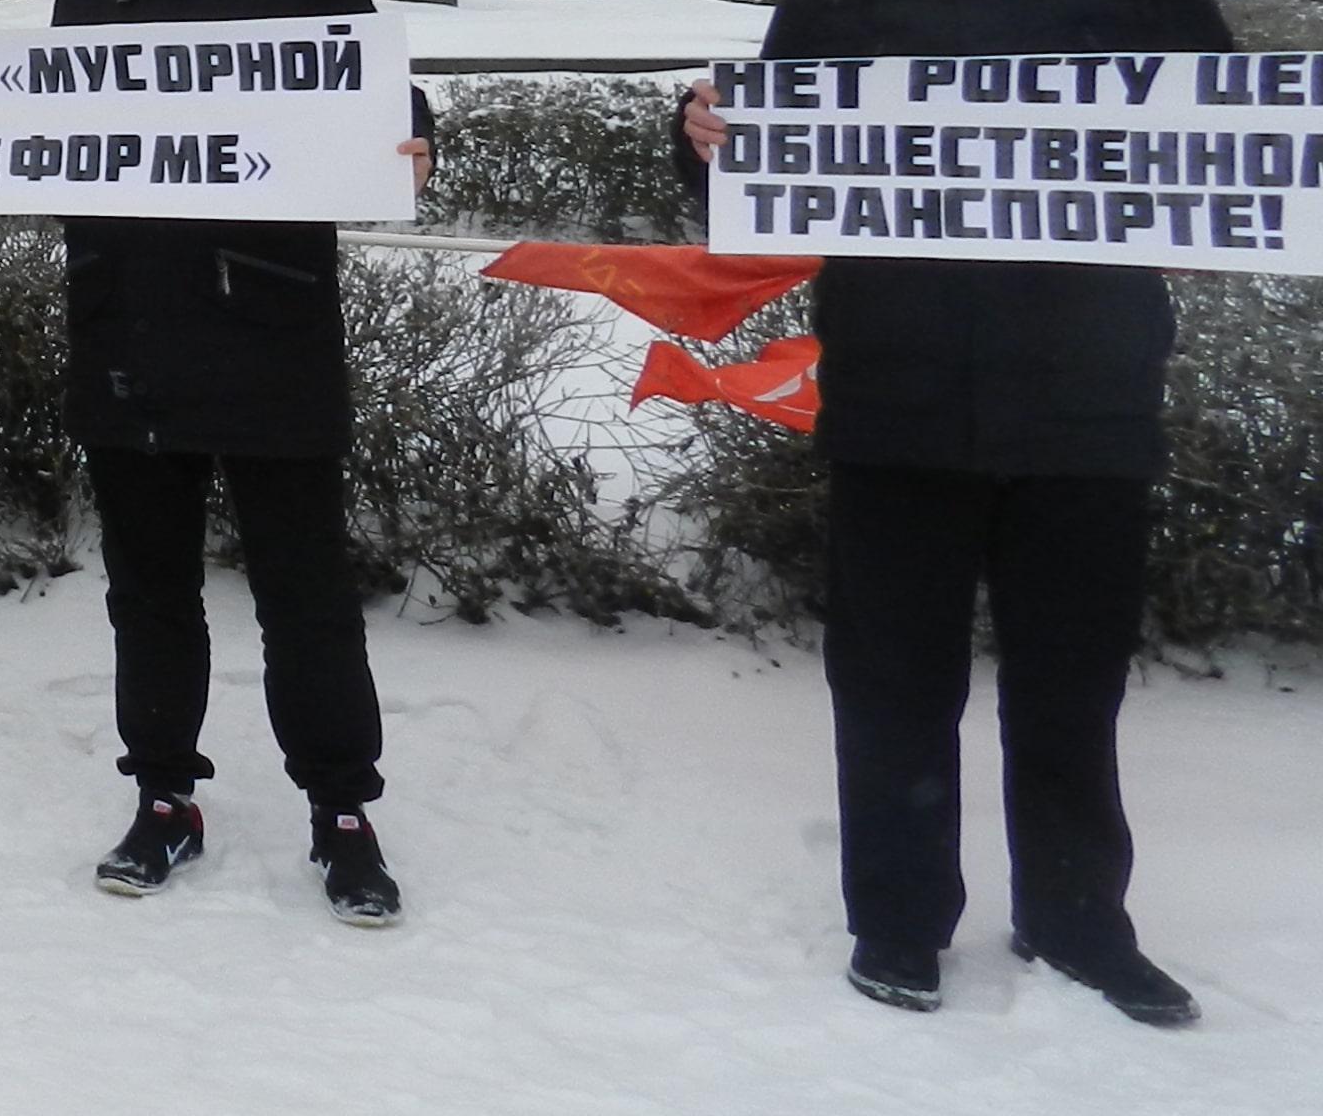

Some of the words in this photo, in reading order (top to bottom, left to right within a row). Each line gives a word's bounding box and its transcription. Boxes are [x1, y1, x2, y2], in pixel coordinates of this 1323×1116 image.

[0, 24, 362, 93] «МУСОРНОЙ
[714, 61, 874, 109] НЕТ
[908, 55, 1165, 105] РОСТУ
[1196, 53, 1323, 106] ЦЕ
[744, 184, 1284, 250] ТРАНСПОРТЕ!
